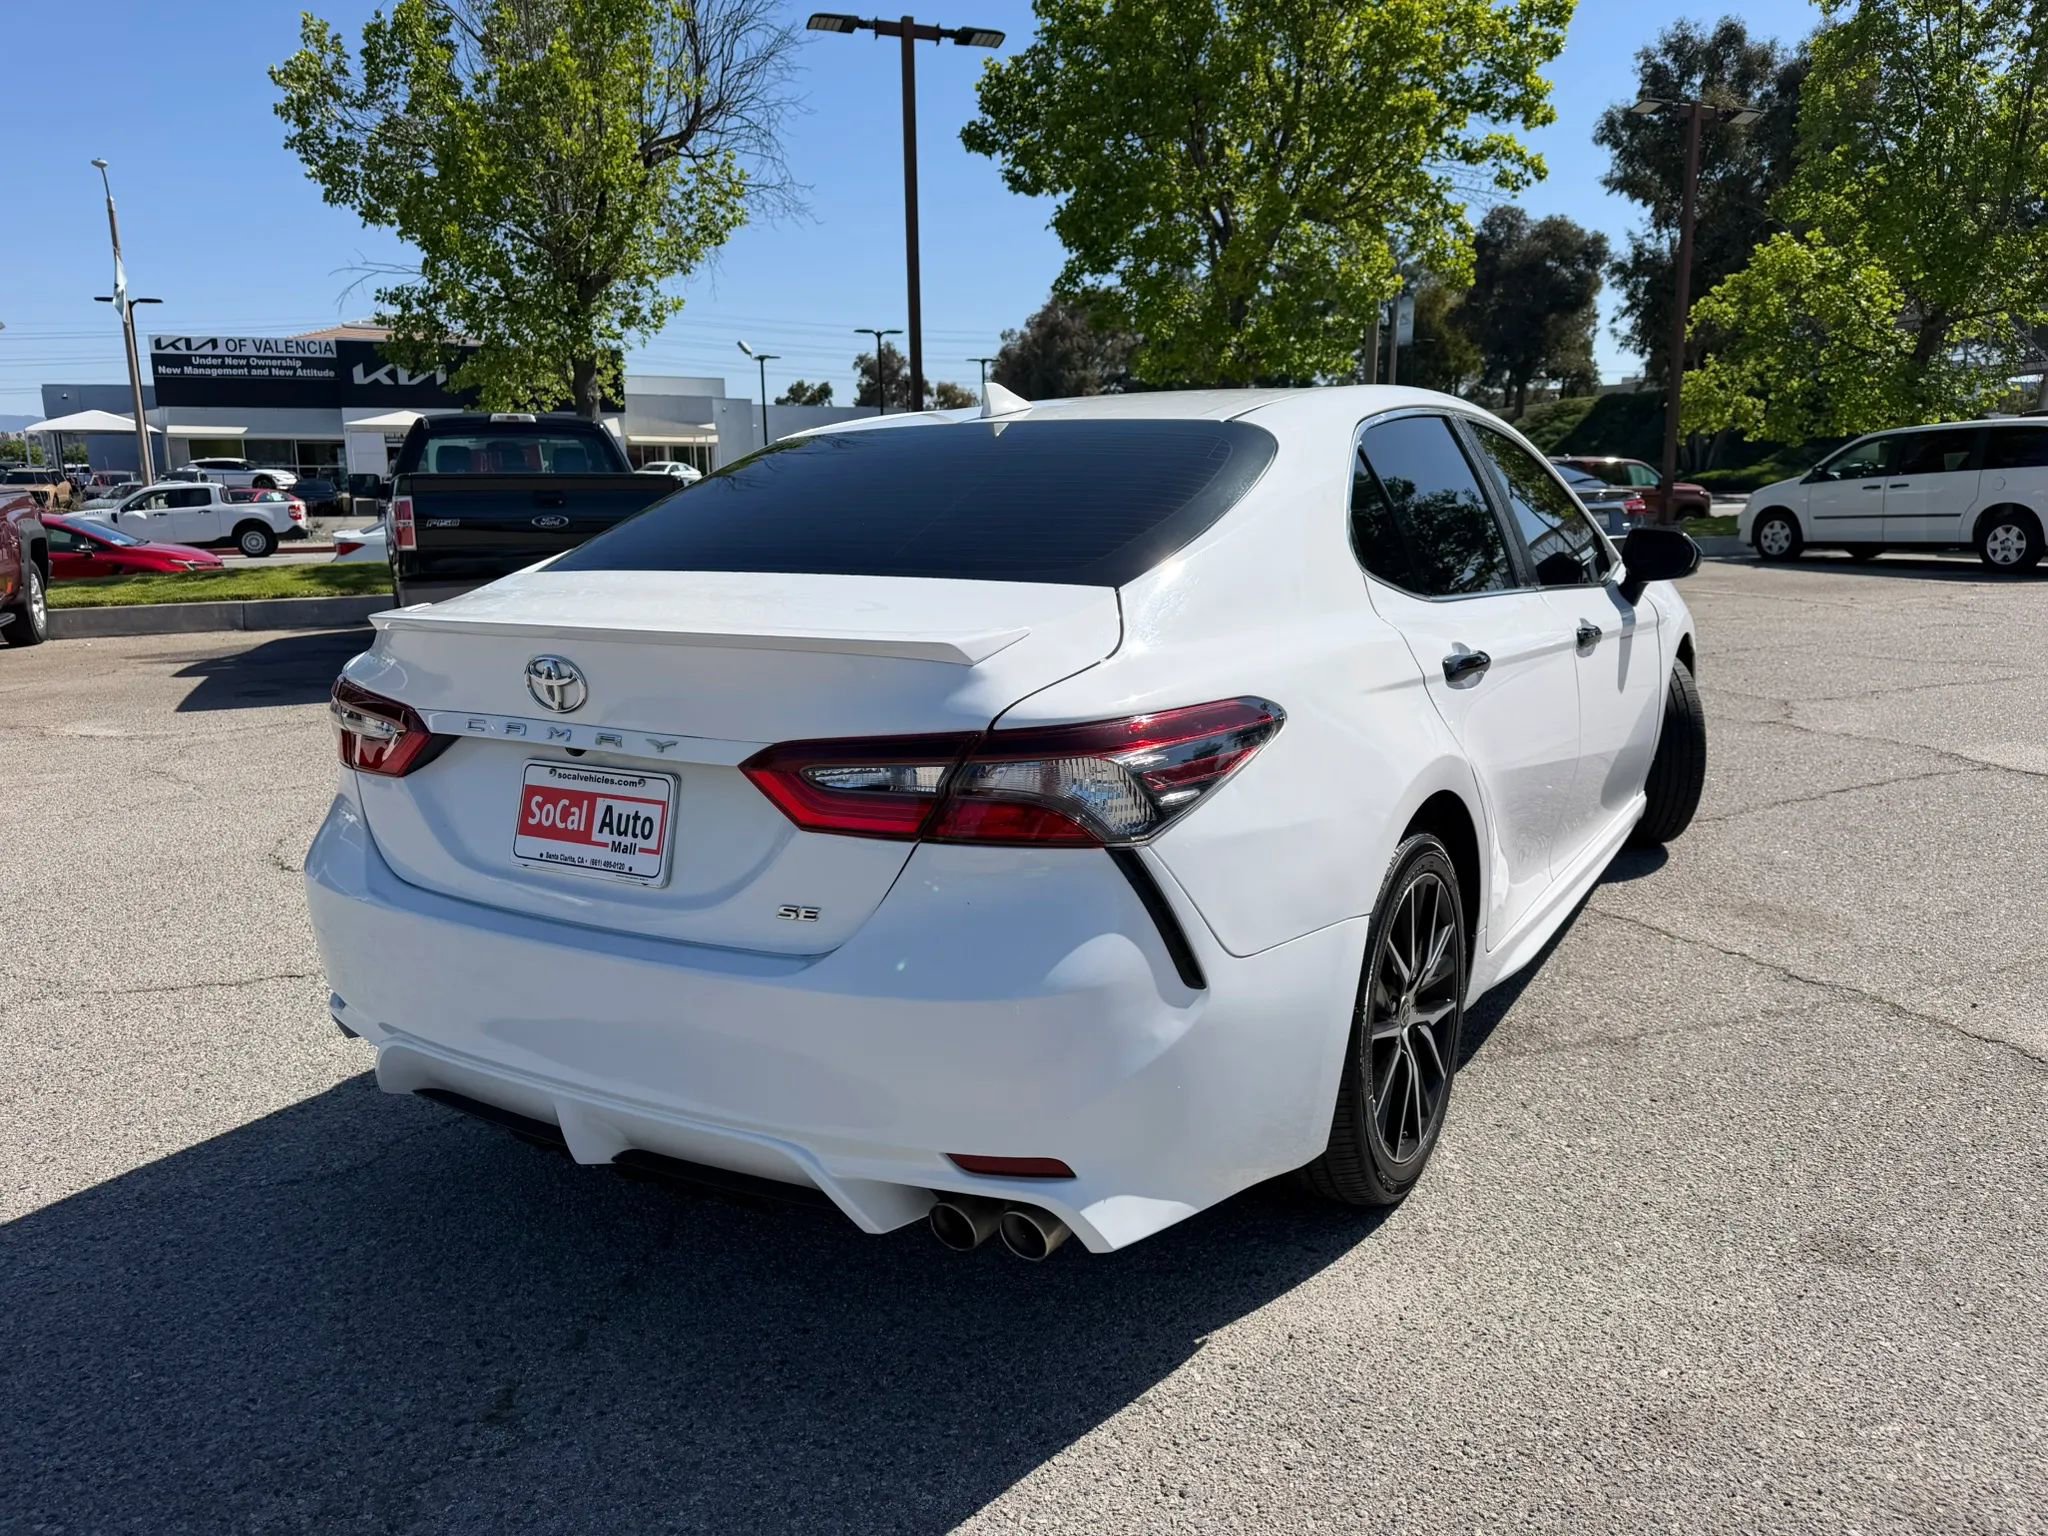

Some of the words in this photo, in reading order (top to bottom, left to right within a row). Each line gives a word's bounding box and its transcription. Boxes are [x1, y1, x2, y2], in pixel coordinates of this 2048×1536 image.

[154, 336, 218, 351] KIA
[225, 338, 248, 352] OF
[252, 339, 335, 355] VALENCIA
[191, 355, 222, 366] Under
[224, 356, 248, 366] New
[250, 357, 302, 368] Ownership
[157, 365, 181, 375] New
[183, 366, 249, 377] Management
[251, 366, 269, 376] and
[271, 367, 294, 377] New
[296, 367, 335, 378] Attitude
[465, 718, 679, 753] CAMRY
[557, 771, 638, 788] socalvehicles.com
[527, 795, 588, 832] SoCal
[598, 804, 654, 841] Auto
[610, 840, 637, 856] Mall
[545, 851, 559, 860] Santa
[577, 856, 585, 864] CA
[776, 904, 822, 922] SE
